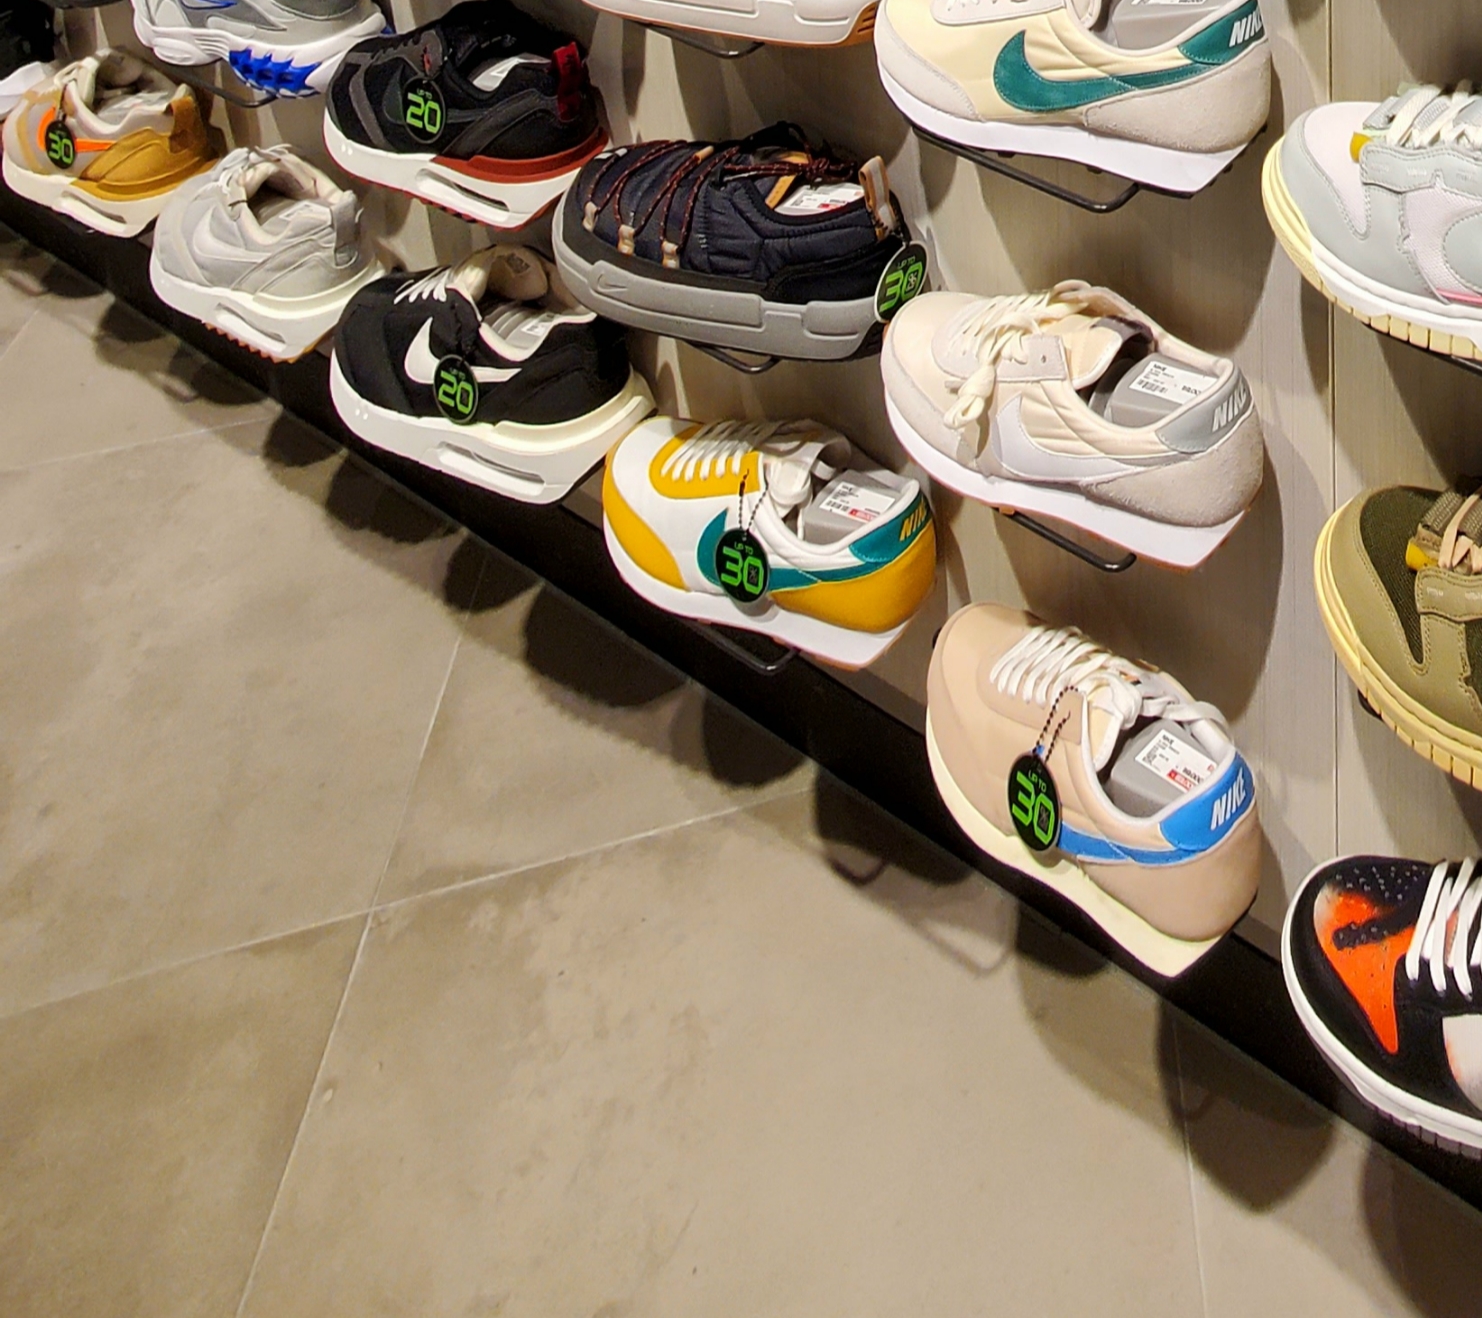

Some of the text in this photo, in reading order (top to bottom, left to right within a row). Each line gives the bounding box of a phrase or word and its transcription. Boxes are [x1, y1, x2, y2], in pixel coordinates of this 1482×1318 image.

[1229, 7, 1262, 48] NIK
[406, 92, 442, 135] 20
[48, 132, 74, 164] 30
[878, 261, 923, 313] 30
[438, 370, 474, 415] 20
[734, 541, 754, 556] UP TO
[721, 546, 765, 596] 30
[1028, 769, 1047, 793] UP TO
[1012, 770, 1056, 846] 30
